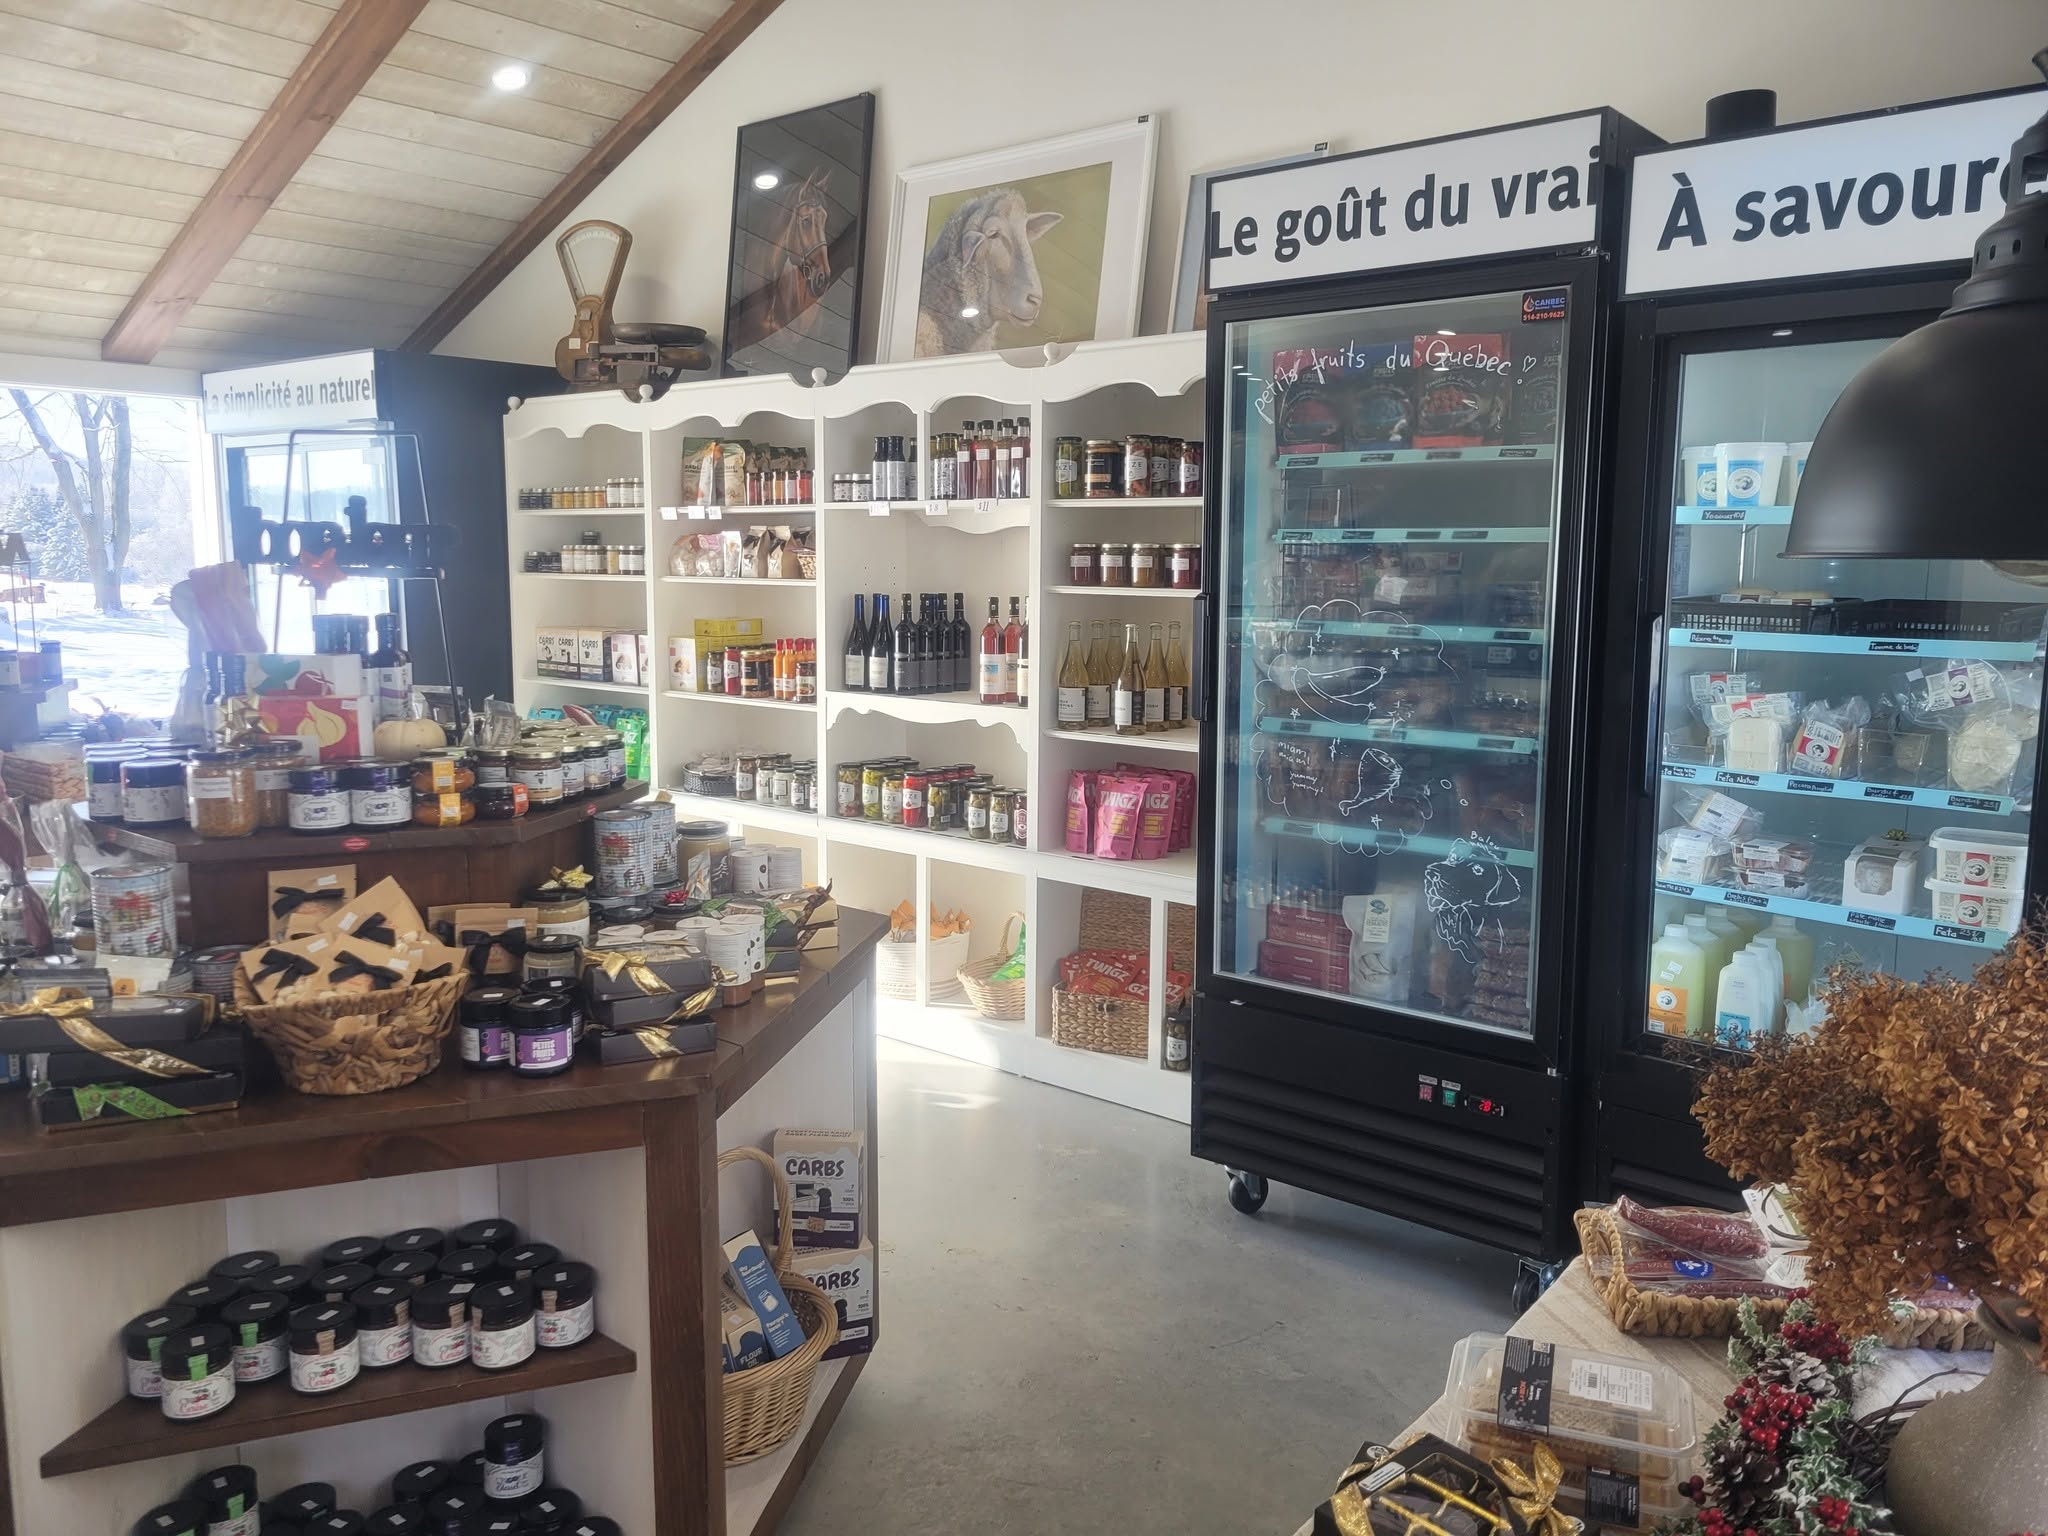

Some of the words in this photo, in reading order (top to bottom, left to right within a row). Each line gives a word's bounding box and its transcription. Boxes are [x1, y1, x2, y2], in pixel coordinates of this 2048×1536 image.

[1210, 210, 1258, 259] Le
[1274, 186, 1387, 263] goût
[1404, 173, 1469, 232] du
[1491, 145, 1601, 219] vrai
[1657, 172, 1707, 251] À
[1534, 297, 1566, 307] CANBEC
[1254, 359, 1299, 424] petits
[1311, 340, 1365, 384] fruits
[1386, 344, 1411, 370] du
[1425, 340, 1512, 376] Québec
[203, 389, 220, 415] La
[223, 379, 292, 417] simplicité
[296, 383, 314, 407] au
[319, 370, 376, 405] naturel
[538, 636, 555, 646] CARBS
[557, 637, 574, 647] CARBS
[581, 639, 599, 649] CARBS
[1717, 772, 1734, 784] Feta
[1100, 790, 1137, 810] TWIGZ
[1935, 925, 1957, 938] Feta
[1085, 957, 1131, 983] TWIGZ
[785, 1158, 845, 1178] CARBS
